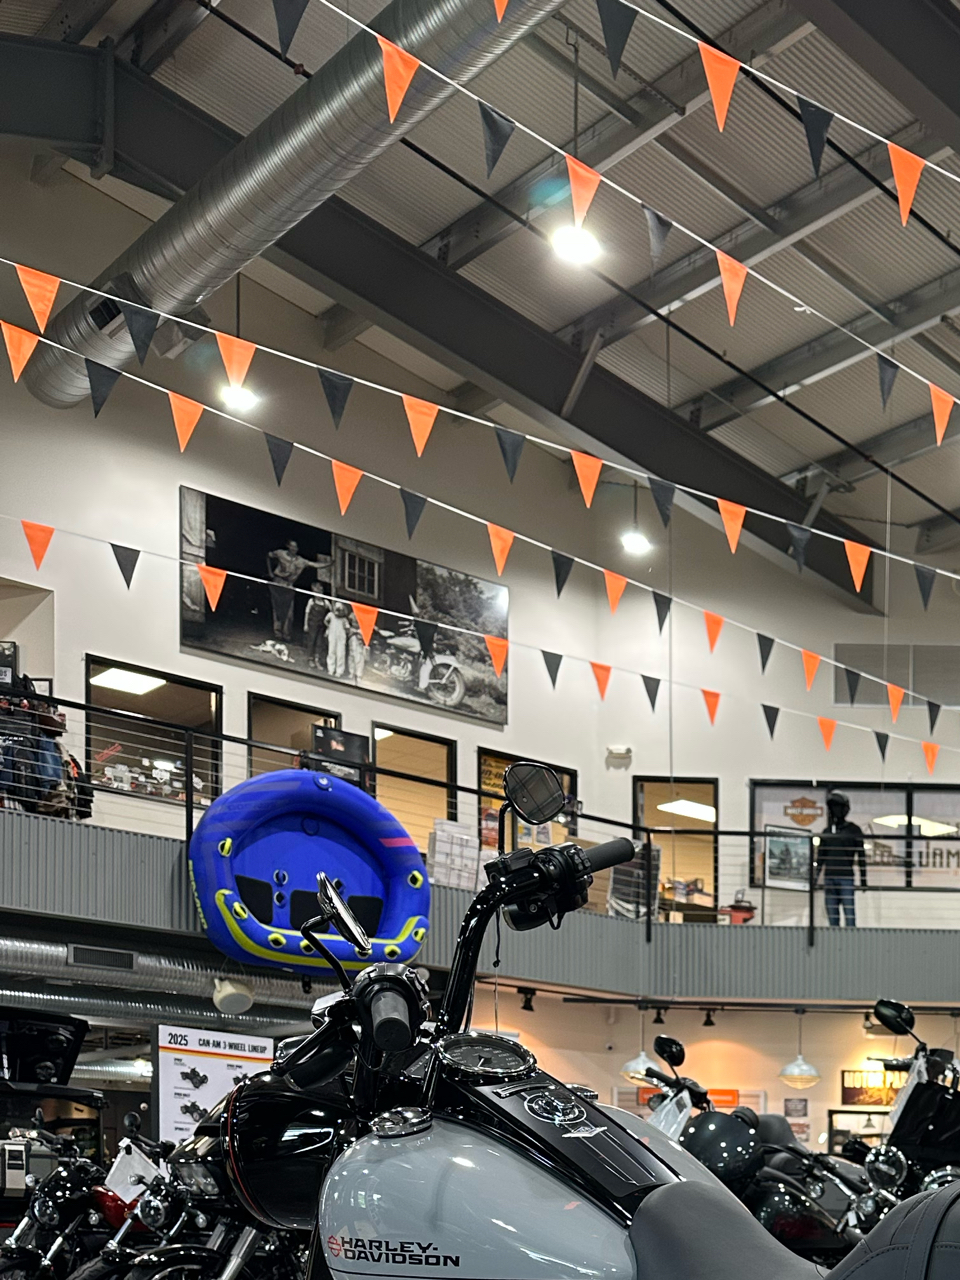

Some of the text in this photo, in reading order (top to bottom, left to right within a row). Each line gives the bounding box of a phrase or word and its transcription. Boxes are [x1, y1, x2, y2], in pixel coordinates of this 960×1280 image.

[168, 1032, 189, 1047] 2025
[248, 1044, 268, 1054] LINEUP
[340, 1236, 439, 1254] HARLEY-
[342, 1248, 461, 1267] DAVIDSON
